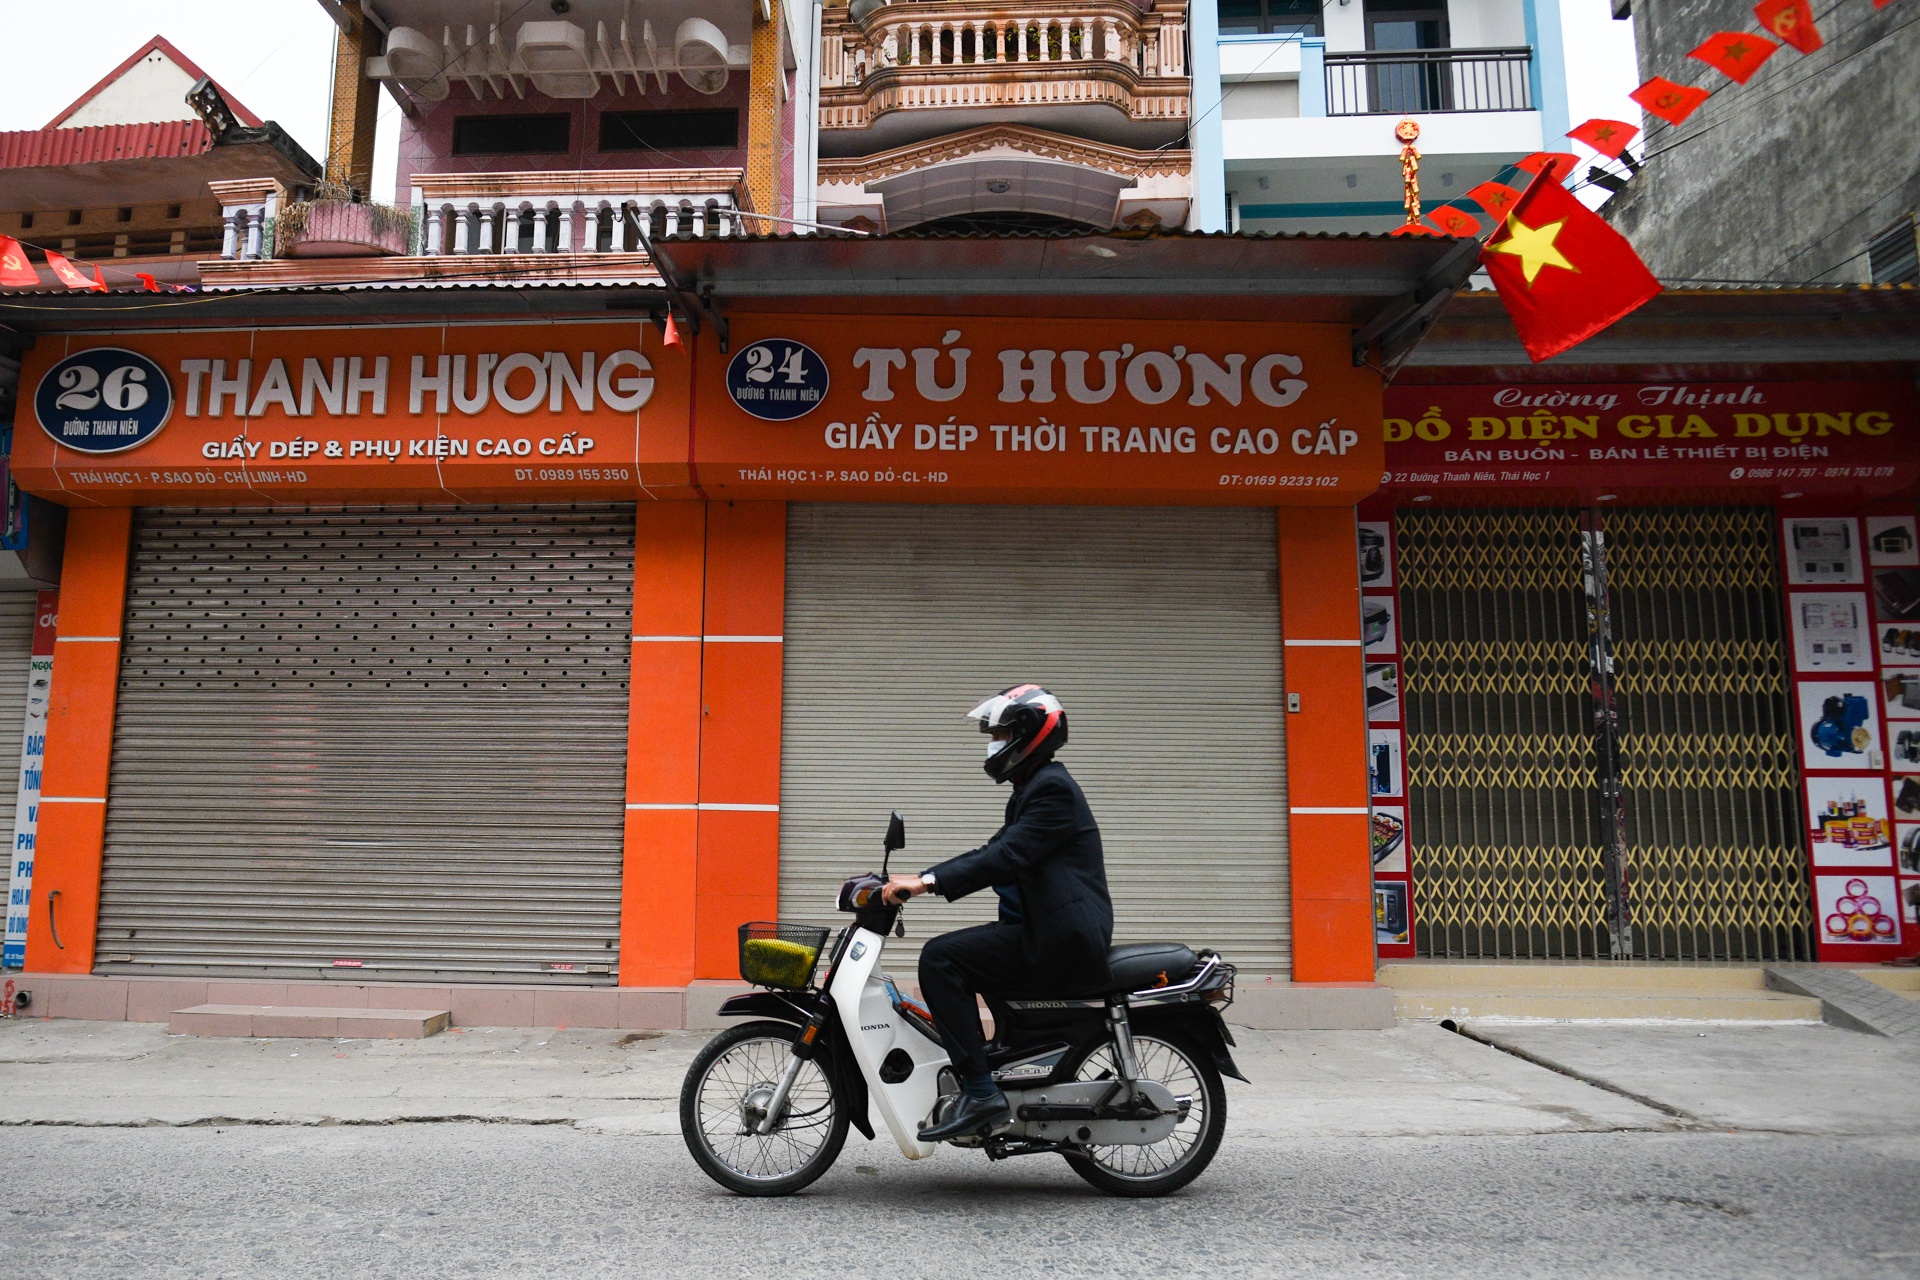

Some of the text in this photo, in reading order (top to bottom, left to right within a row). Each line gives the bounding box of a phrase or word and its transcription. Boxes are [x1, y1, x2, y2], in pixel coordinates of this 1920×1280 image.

[746, 346, 809, 384] 24
[853, 330, 1309, 408] TÚ HƯƠNG
[56, 365, 149, 411] 26
[180, 349, 656, 418] THANH HƯƠNG
[769, 388, 797, 401] THANH
[800, 387, 820, 402] NIÊN
[1637, 385, 1767, 409] Thịnh
[63, 416, 139, 436] ĐƯỜNG THANH NIÊN
[824, 411, 1359, 456] GIẦY DÉP THỜI TRANG CAO CẤP
[1383, 405, 1895, 447] ĐỒ ĐIỆN GIA DỤNG
[202, 430, 595, 463] GIẦY DÉP & PHỤ KIỆN CAO CẤP
[1445, 448, 1492, 462] BÁN
[1498, 447, 1565, 461] BUÔN
[1589, 446, 1637, 460] BÁN
[1644, 444, 1670, 459] LẺ
[1673, 443, 1739, 459] THIẾT
[1746, 446, 1767, 461] BỊ
[1773, 444, 1829, 460] ĐIỆN
[70, 469, 103, 484] THÁI
[104, 472, 132, 487] HỌC
[577, 468, 601, 481] 155
[603, 468, 629, 481] 350
[739, 467, 772, 481] THÁI
[777, 469, 808, 484] HỌC
[1219, 474, 1243, 486] ĐT:
[1244, 475, 1277, 486] 0169
[1394, 472, 1408, 483] 22
[1443, 471, 1471, 482] Thanh
[1500, 471, 1520, 481] Thái
[1522, 471, 1541, 482] Học
[1544, 470, 1550, 481] 1
[1776, 468, 1796, 478] 147
[1026, 1001, 1069, 1009] HONDA
